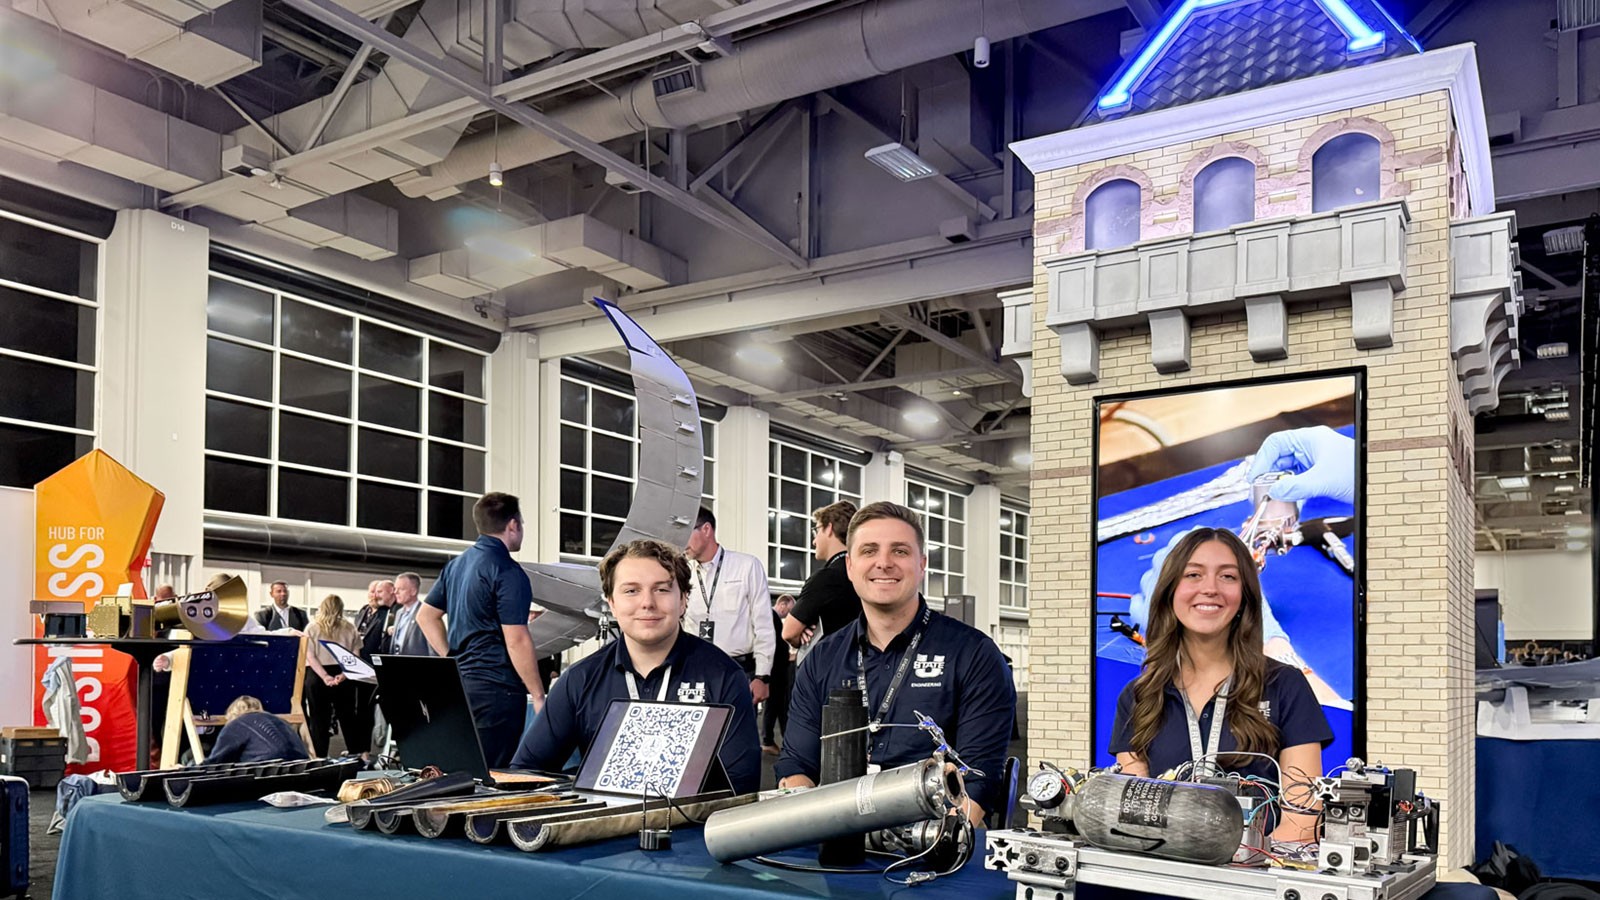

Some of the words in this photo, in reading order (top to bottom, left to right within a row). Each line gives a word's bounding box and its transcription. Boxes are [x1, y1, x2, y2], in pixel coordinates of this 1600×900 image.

[171, 222, 185, 232] D14
[48, 527, 75, 540] HUB
[80, 527, 104, 540] FOR
[913, 660, 945, 669] STATE
[677, 688, 705, 696] STATE
